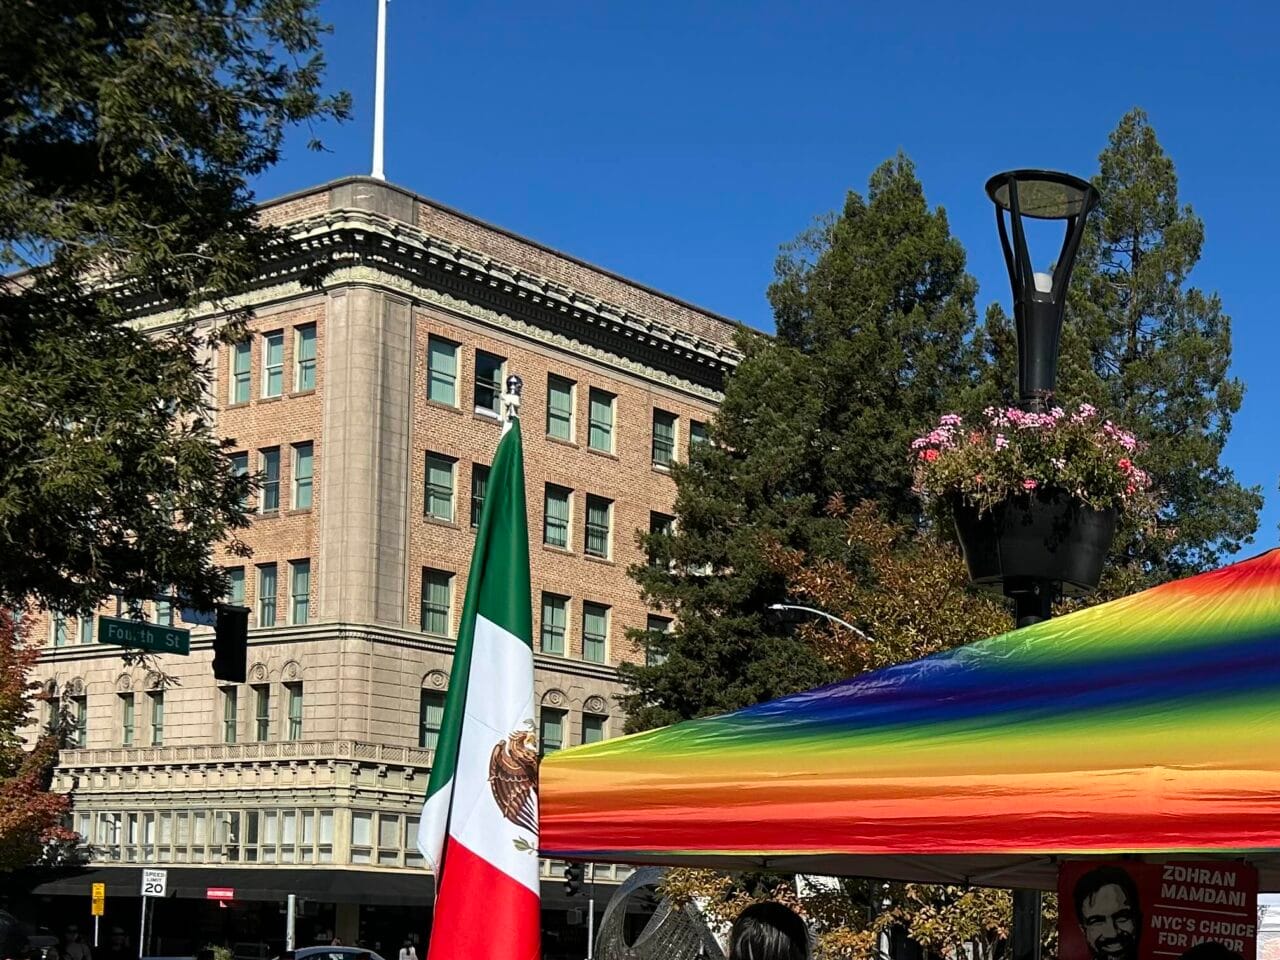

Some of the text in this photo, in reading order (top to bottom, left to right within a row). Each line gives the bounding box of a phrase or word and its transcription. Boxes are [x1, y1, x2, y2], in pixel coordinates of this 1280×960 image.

[108, 624, 180, 648] Fouth St
[1162, 865, 1236, 887] ZOHRAN
[145, 883, 163, 893] 20
[1161, 884, 1246, 907] MAMDANI
[1151, 915, 1255, 937] NYC'S CHOICE
[1159, 932, 1187, 946] FOR
